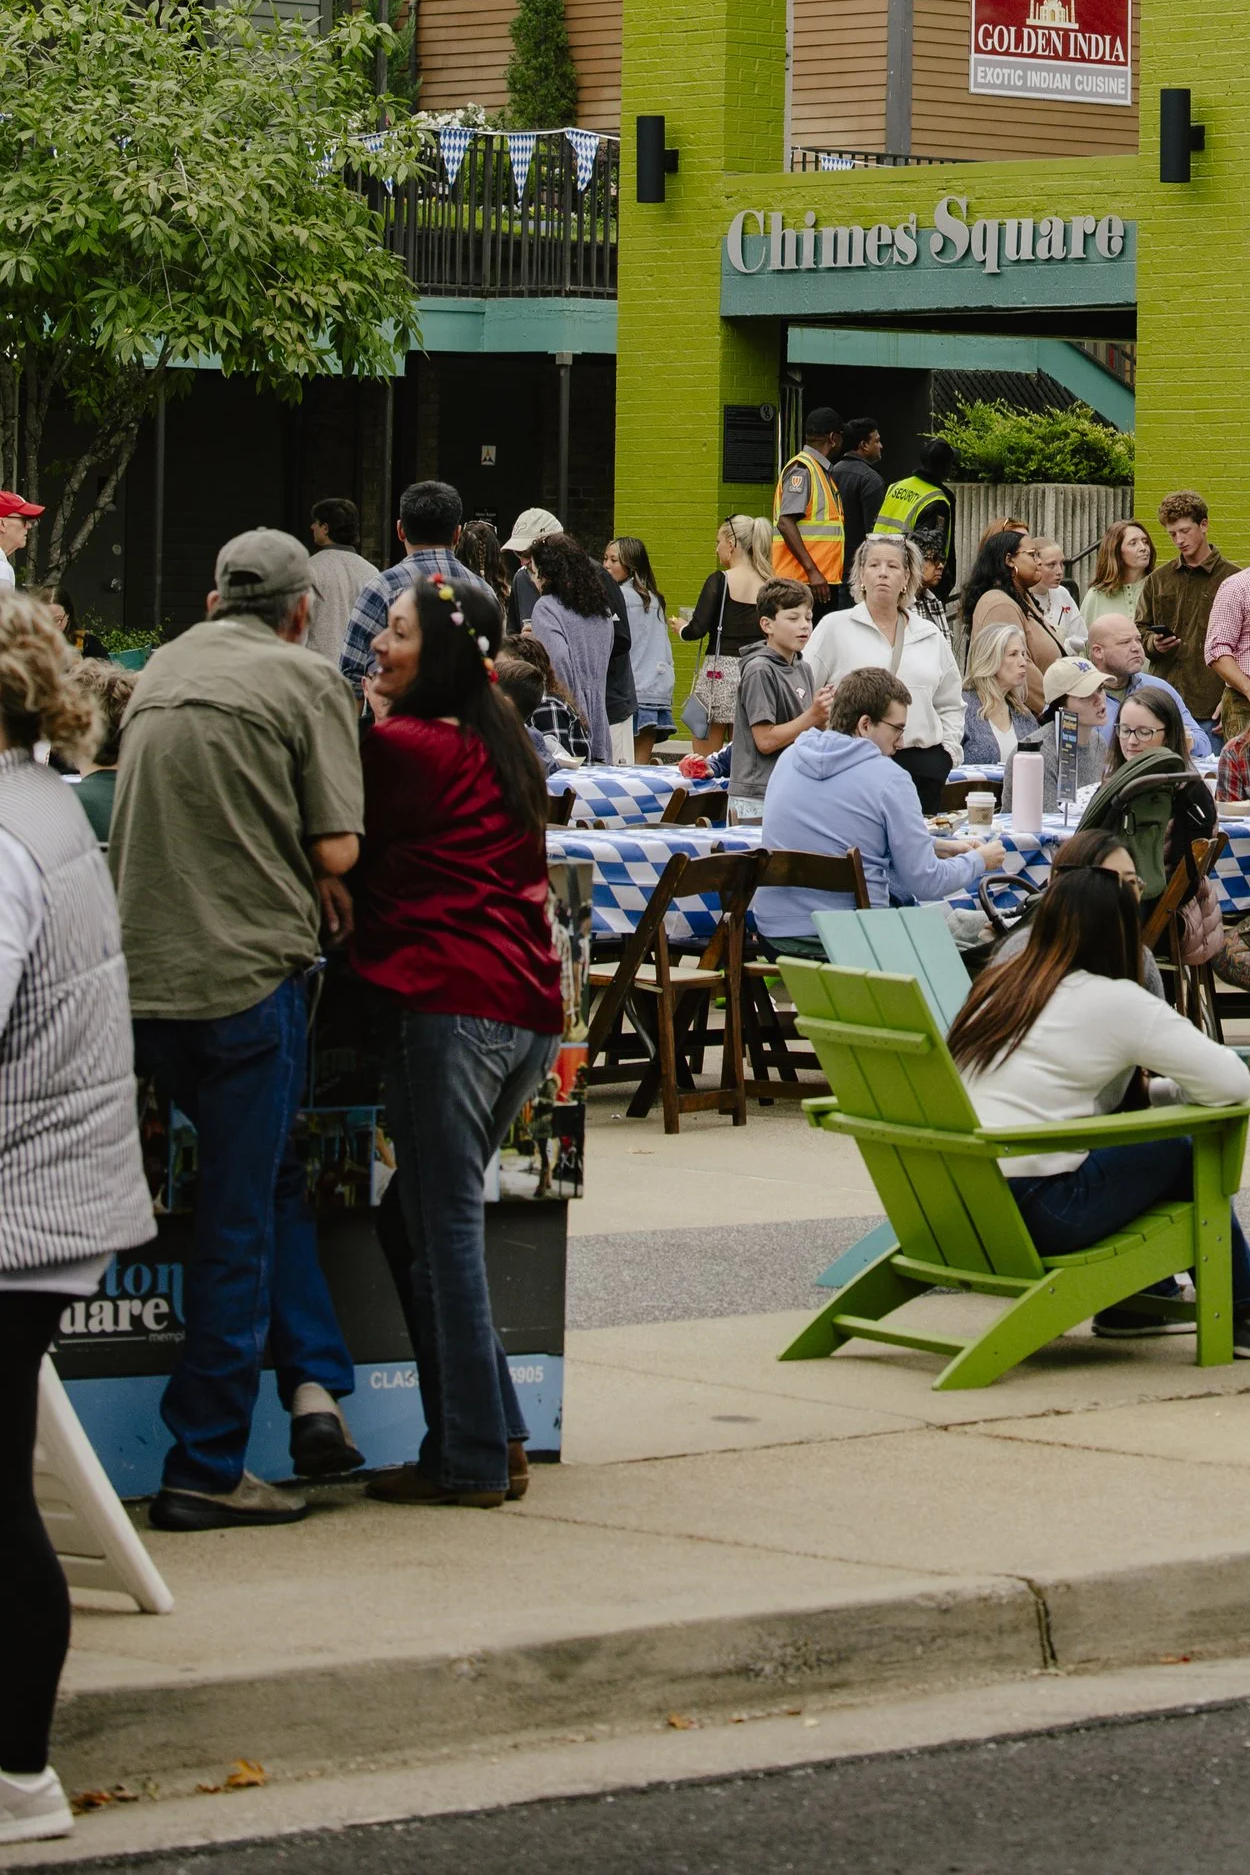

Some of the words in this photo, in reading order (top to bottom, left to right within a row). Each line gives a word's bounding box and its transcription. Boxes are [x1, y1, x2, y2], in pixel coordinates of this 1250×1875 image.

[978, 23, 1063, 57] GOLDEN
[1068, 31, 1126, 63] INDIA
[976, 66, 1023, 88] EXOTIC
[1026, 70, 1071, 91] INDIAN
[1074, 74, 1126, 95] CUISINE
[726, 208, 919, 275] Chimes
[929, 195, 1125, 274] Square
[891, 487, 921, 504] SECURITY
[59, 1297, 170, 1335] uare
[370, 1369, 419, 1390] CLAS
